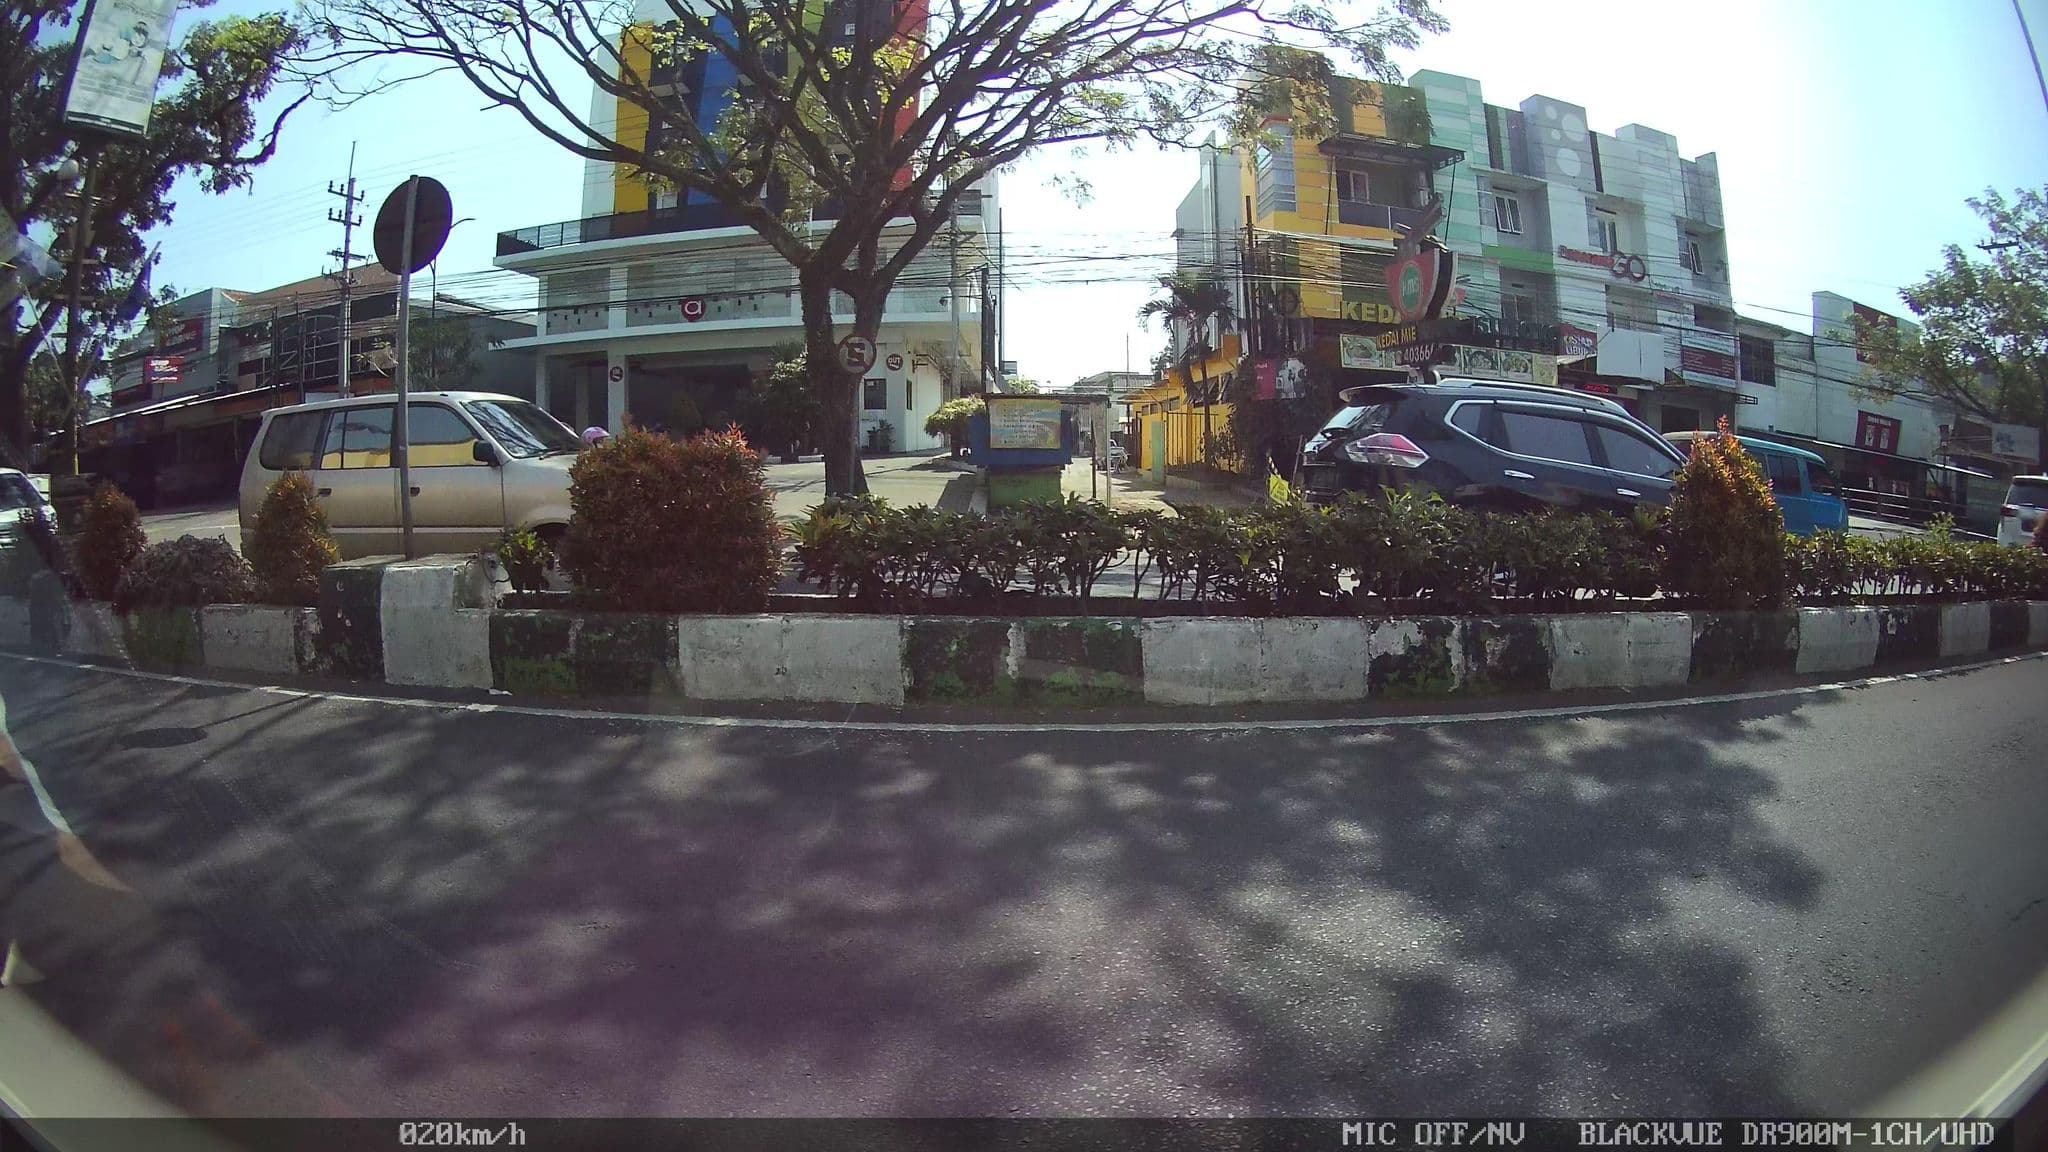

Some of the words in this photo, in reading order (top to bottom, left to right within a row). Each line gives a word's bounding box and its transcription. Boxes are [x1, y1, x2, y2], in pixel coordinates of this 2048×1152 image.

[1376, 330, 1400, 349] KEDAI
[1401, 326, 1417, 345] MIE
[888, 357, 901, 365] OUT
